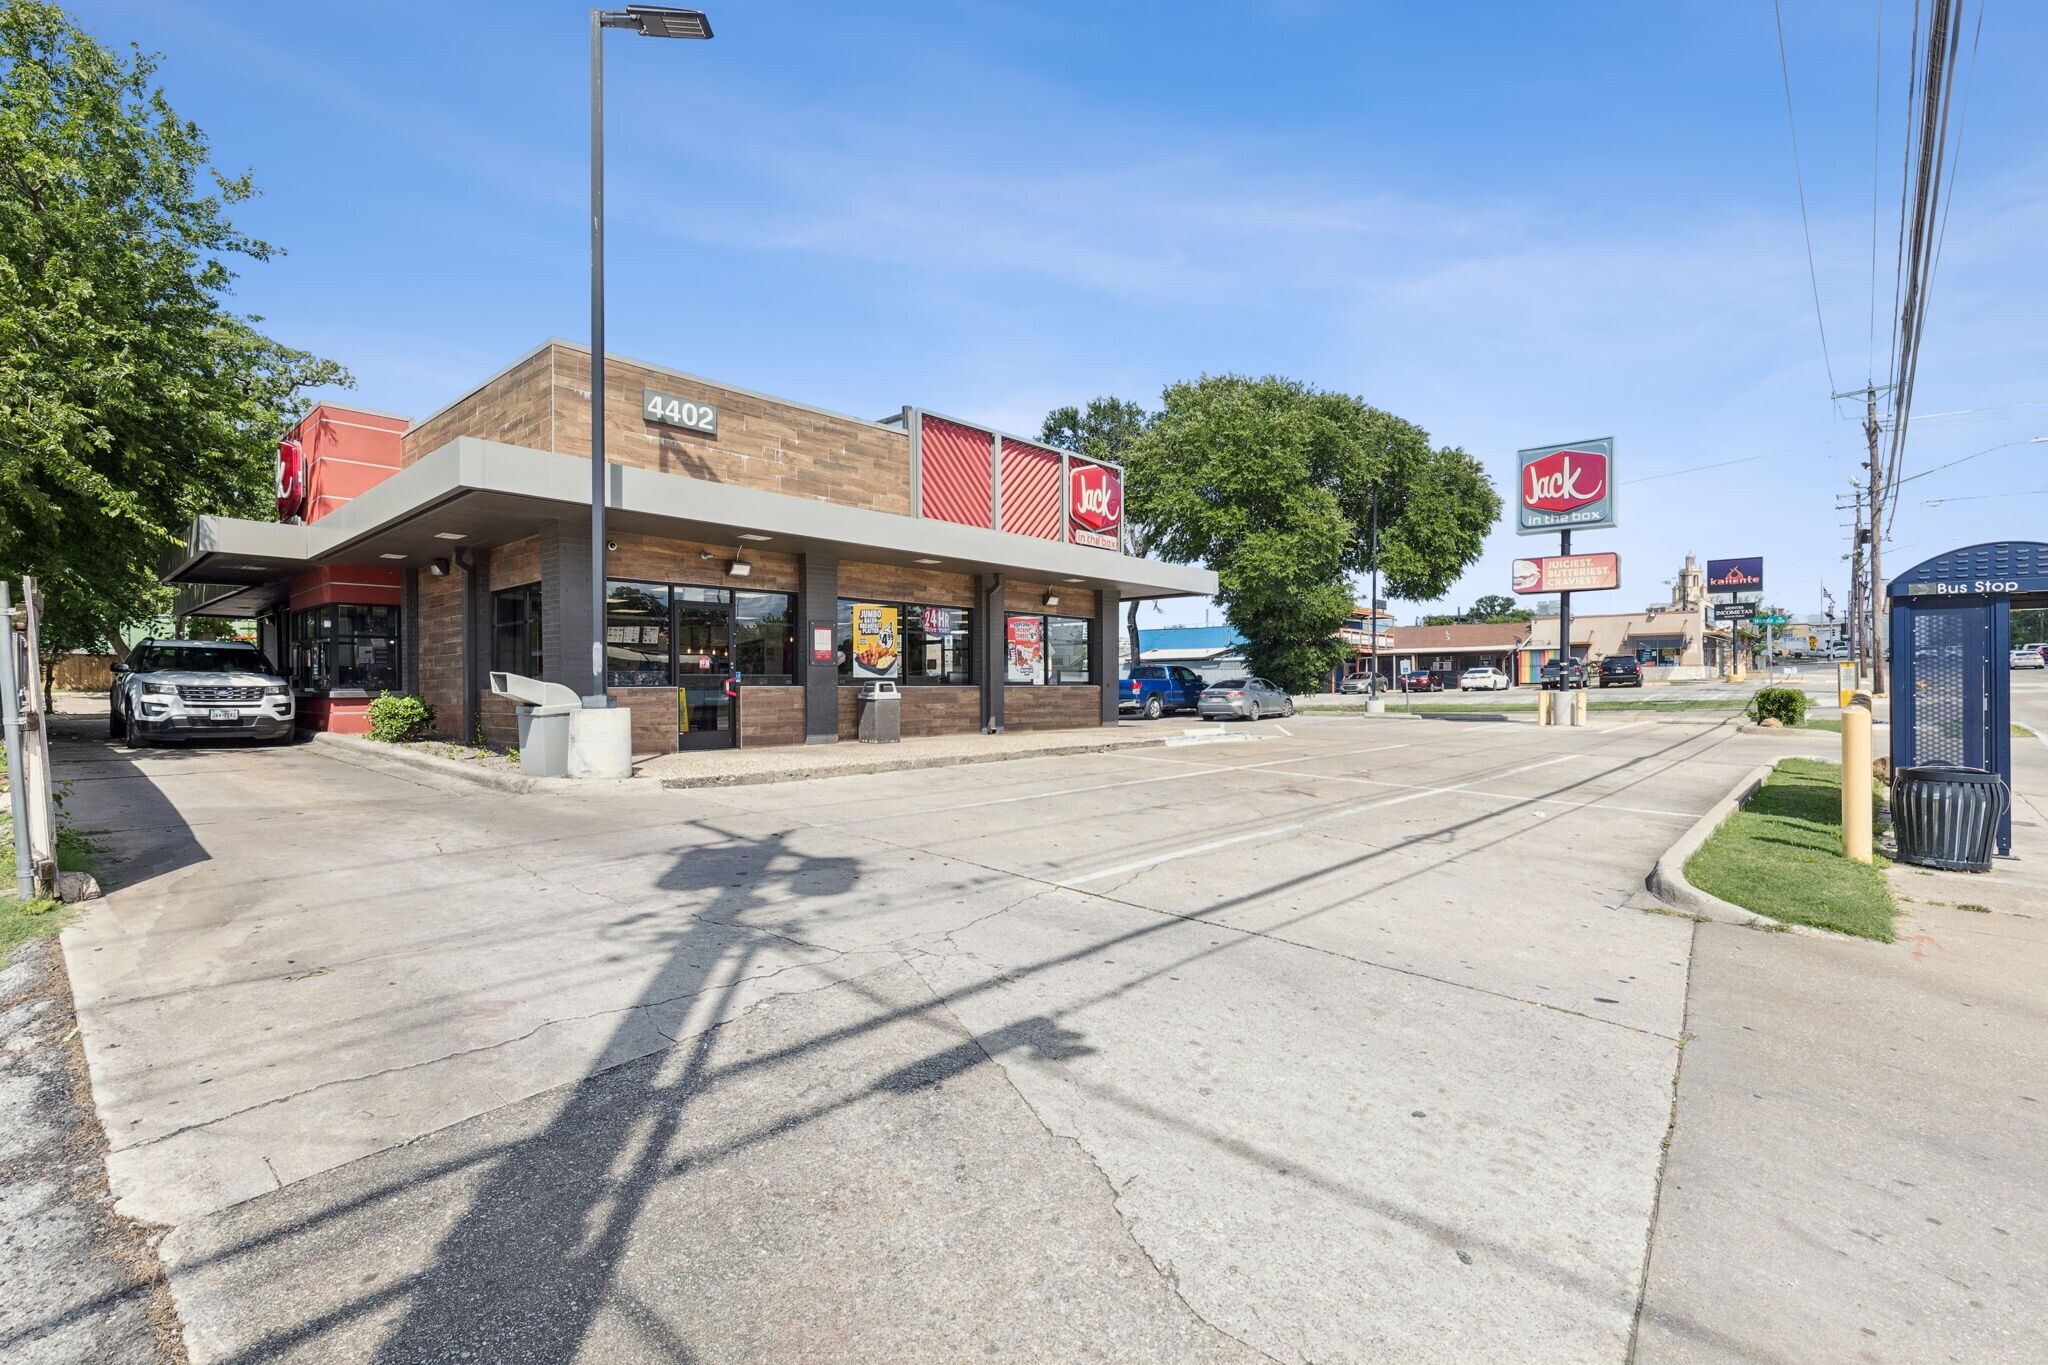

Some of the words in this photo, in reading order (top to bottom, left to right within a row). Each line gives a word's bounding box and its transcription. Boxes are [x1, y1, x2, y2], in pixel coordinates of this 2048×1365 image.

[647, 395, 714, 431] 4402
[1525, 456, 1603, 505] Jack
[1077, 474, 1120, 521] Jack
[1528, 514, 1541, 526] in
[1544, 513, 1569, 525] the
[1572, 511, 1600, 521] box
[1078, 533, 1087, 543] in
[1088, 535, 1100, 545] the
[1101, 537, 1117, 549] box
[1547, 558, 1595, 569] JUICIEST.
[1547, 566, 1610, 578] BUTTERIEST.
[1937, 583, 1968, 594] Bus
[1974, 580, 2019, 592] Stop
[860, 609, 882, 619] JUMBO
[924, 609, 937, 628] 24
[938, 609, 950, 628] HR
